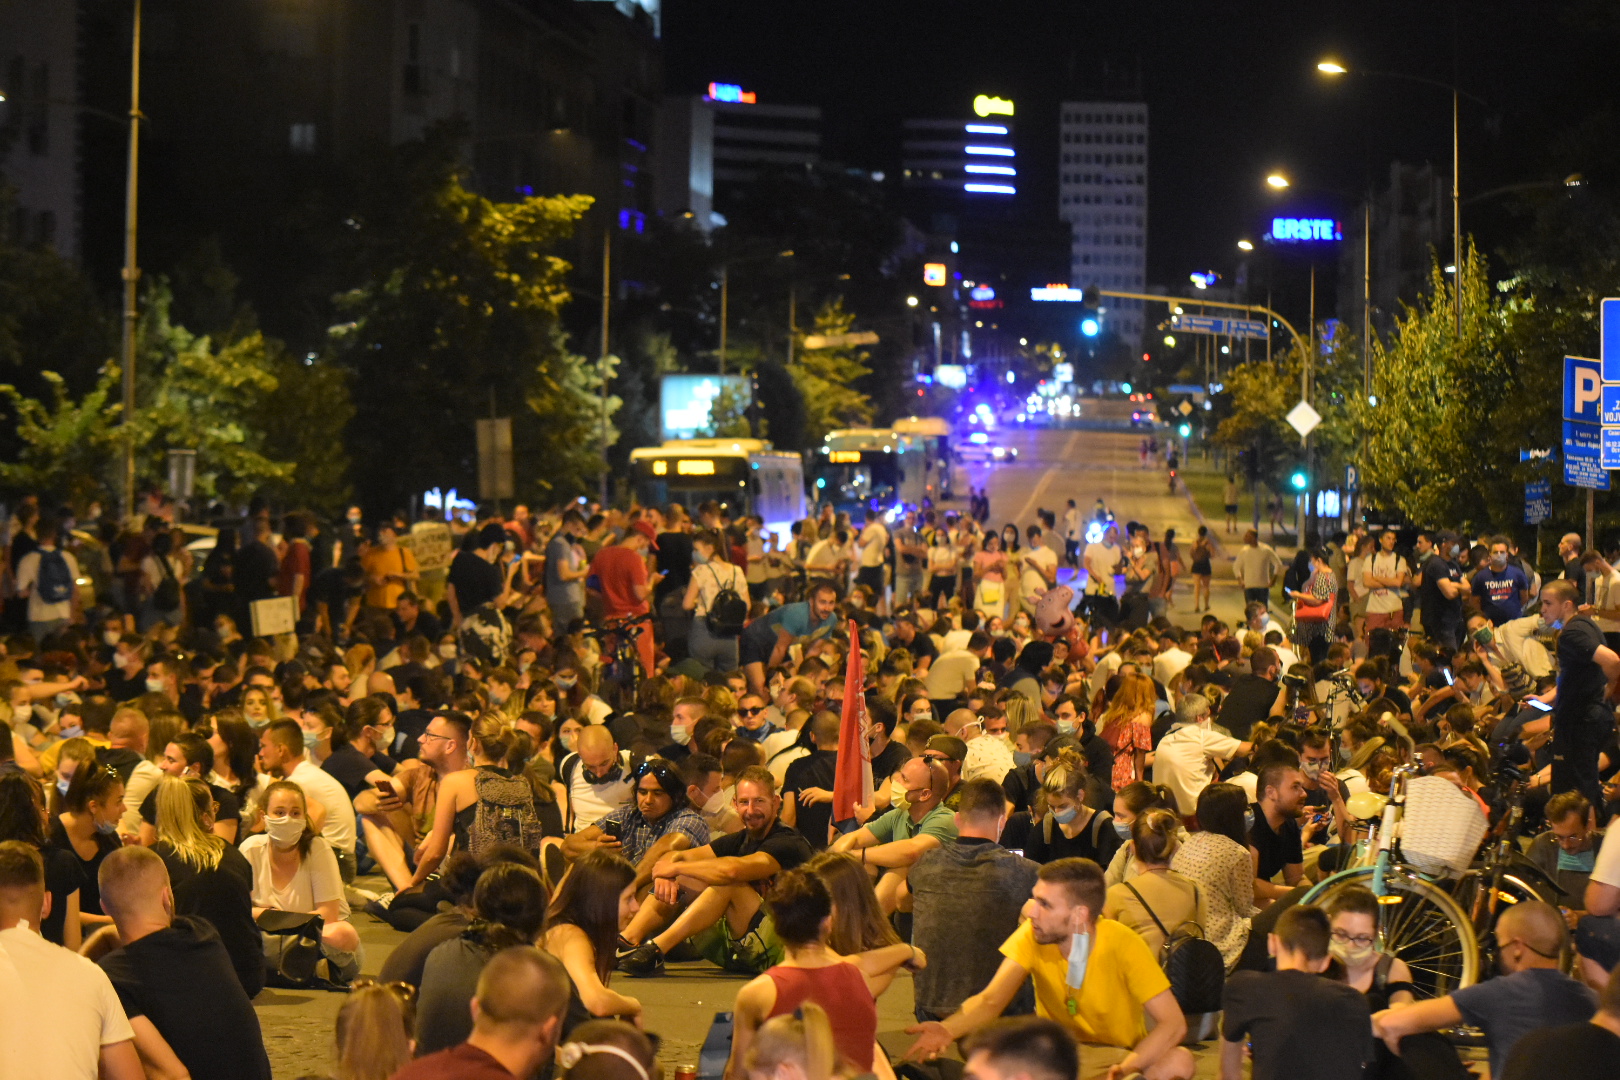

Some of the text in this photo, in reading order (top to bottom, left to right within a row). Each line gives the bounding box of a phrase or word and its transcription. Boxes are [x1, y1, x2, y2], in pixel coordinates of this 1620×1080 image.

[1273, 218, 1333, 240] ERSTE
[1575, 366, 1601, 414] P
[1485, 579, 1514, 590] TOMMY
